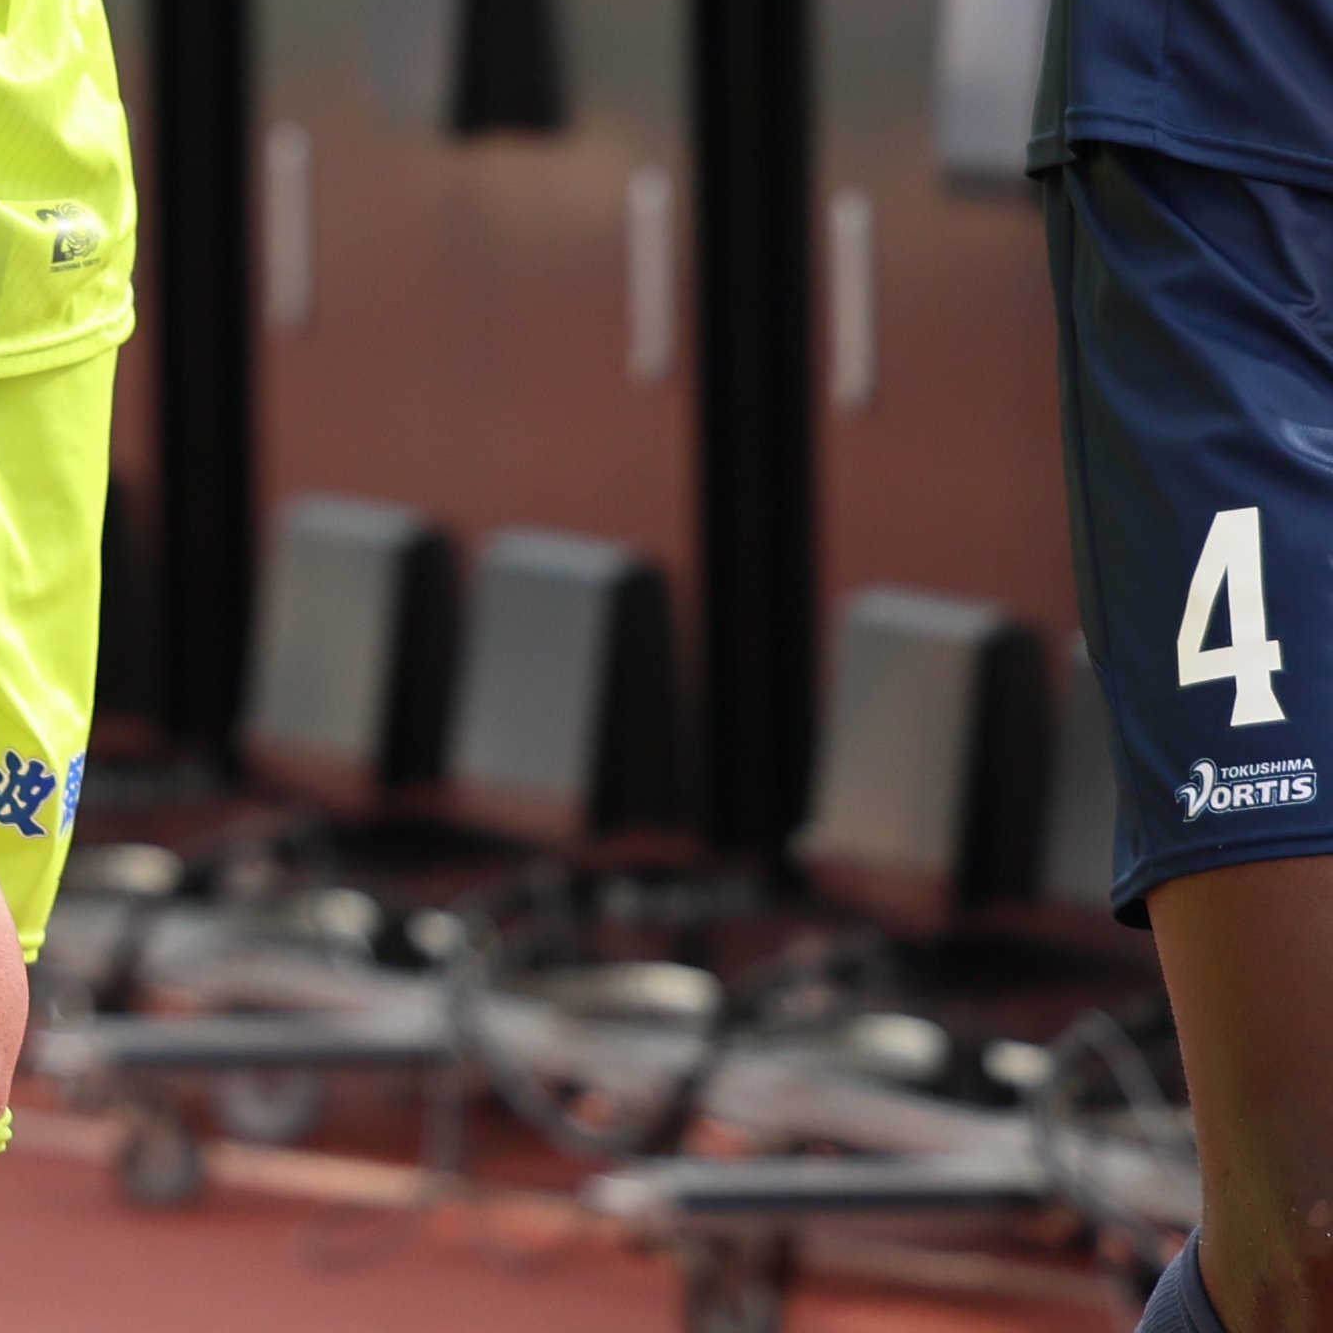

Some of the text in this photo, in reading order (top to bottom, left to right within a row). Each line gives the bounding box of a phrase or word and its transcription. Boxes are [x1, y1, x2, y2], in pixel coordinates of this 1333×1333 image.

[1176, 506, 1286, 727] 4
[1175, 758, 1317, 822] VORTIS
[1221, 757, 1314, 780] TOKUSHIMA
